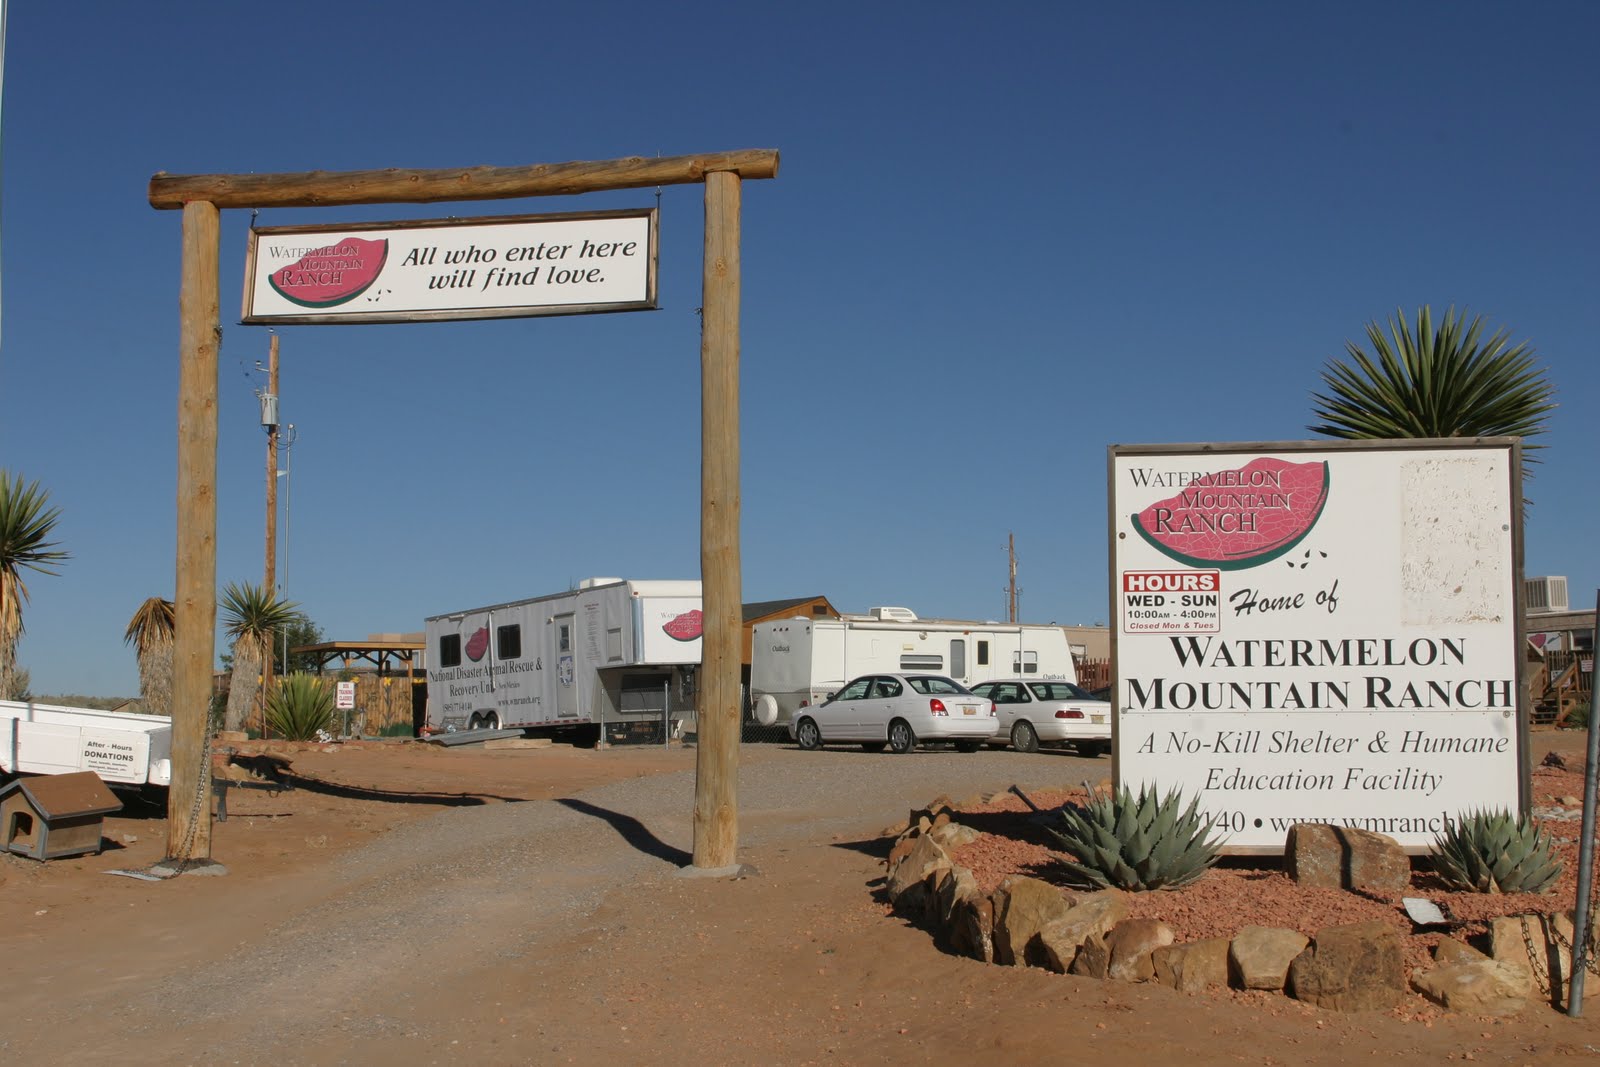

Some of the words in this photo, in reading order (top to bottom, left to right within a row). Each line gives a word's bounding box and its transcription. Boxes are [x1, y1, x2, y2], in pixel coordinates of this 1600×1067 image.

[269, 246, 360, 259] WATERMELON
[400, 247, 437, 267] All
[444, 245, 497, 265] who
[505, 242, 573, 262] enter
[579, 240, 637, 259] here
[297, 259, 364, 272] MOUNTAIN
[280, 270, 343, 287] RANCH
[428, 269, 476, 290] will
[480, 266, 541, 293] find
[546, 266, 605, 285] love.
[1129, 468, 1282, 488] WATERMELON
[1178, 490, 1292, 511] MOUNTAIN
[1152, 508, 1258, 534] RANCH
[1128, 575, 1215, 591] HOURS
[1127, 595, 1165, 607] WED
[1181, 594, 1217, 607] SUN
[1229, 588, 1305, 617] Home
[1315, 578, 1339, 614] of
[1127, 610, 1170, 619] 10:00AM
[1180, 610, 1217, 619] 4:00PM
[1130, 622, 1160, 630] Closed
[1193, 621, 1214, 629] Tues
[1168, 636, 1466, 668] WATERMELON
[430, 668, 455, 683] National
[456, 667, 483, 680] Disaster
[484, 660, 508, 677] Anmal
[509, 660, 533, 674] Rescue
[535, 656, 542, 671] &
[450, 684, 478, 698] Recovery
[480, 680, 496, 694] Uni
[1125, 678, 1351, 710] MOUNTAIN
[1362, 676, 1514, 708] RANCH
[1137, 731, 1156, 753] A
[1165, 730, 1261, 754] No-Kill
[1268, 730, 1359, 754] Shelter
[1367, 730, 1390, 754] &
[1400, 730, 1509, 753] Humane
[84, 750, 134, 762] DONATIONS
[1204, 767, 1334, 790] Education
[1342, 766, 1443, 797] Facility
[1270, 811, 1456, 833] wwmranch
